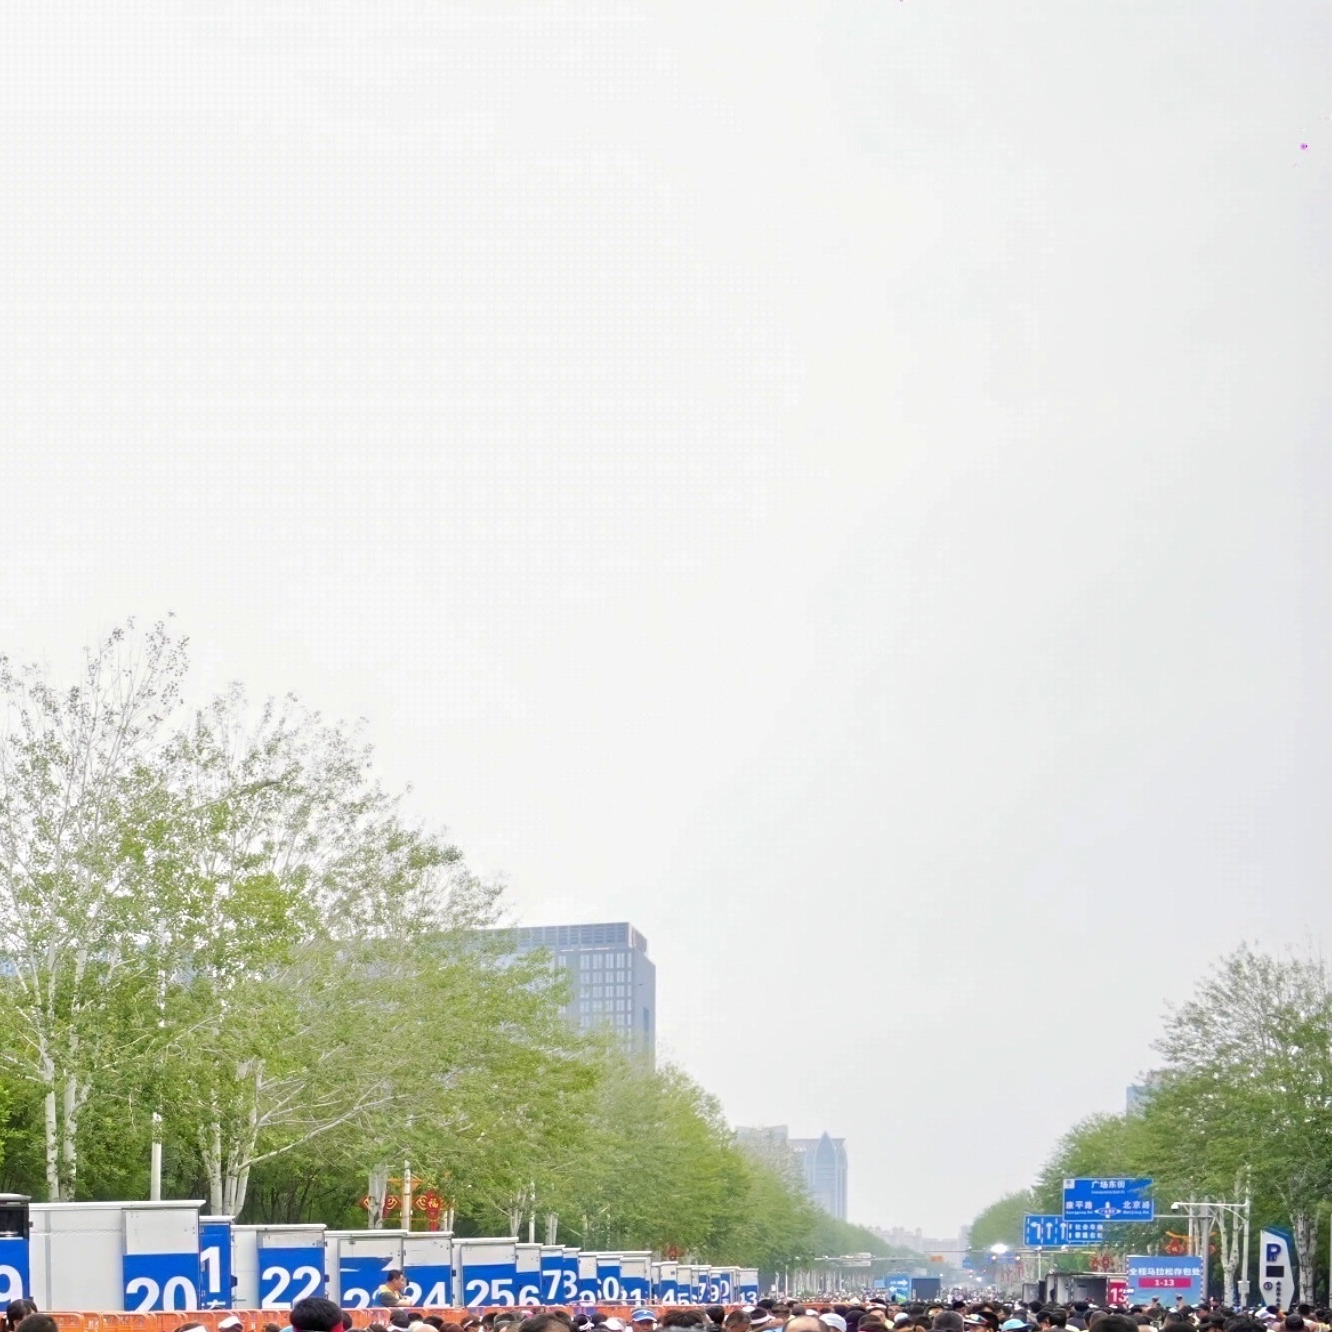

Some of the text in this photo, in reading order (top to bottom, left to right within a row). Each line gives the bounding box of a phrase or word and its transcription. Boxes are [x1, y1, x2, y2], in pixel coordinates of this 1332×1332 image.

[125, 1276, 198, 1312] 20
[261, 1266, 322, 1310] 22
[466, 1278, 515, 1307] 25
